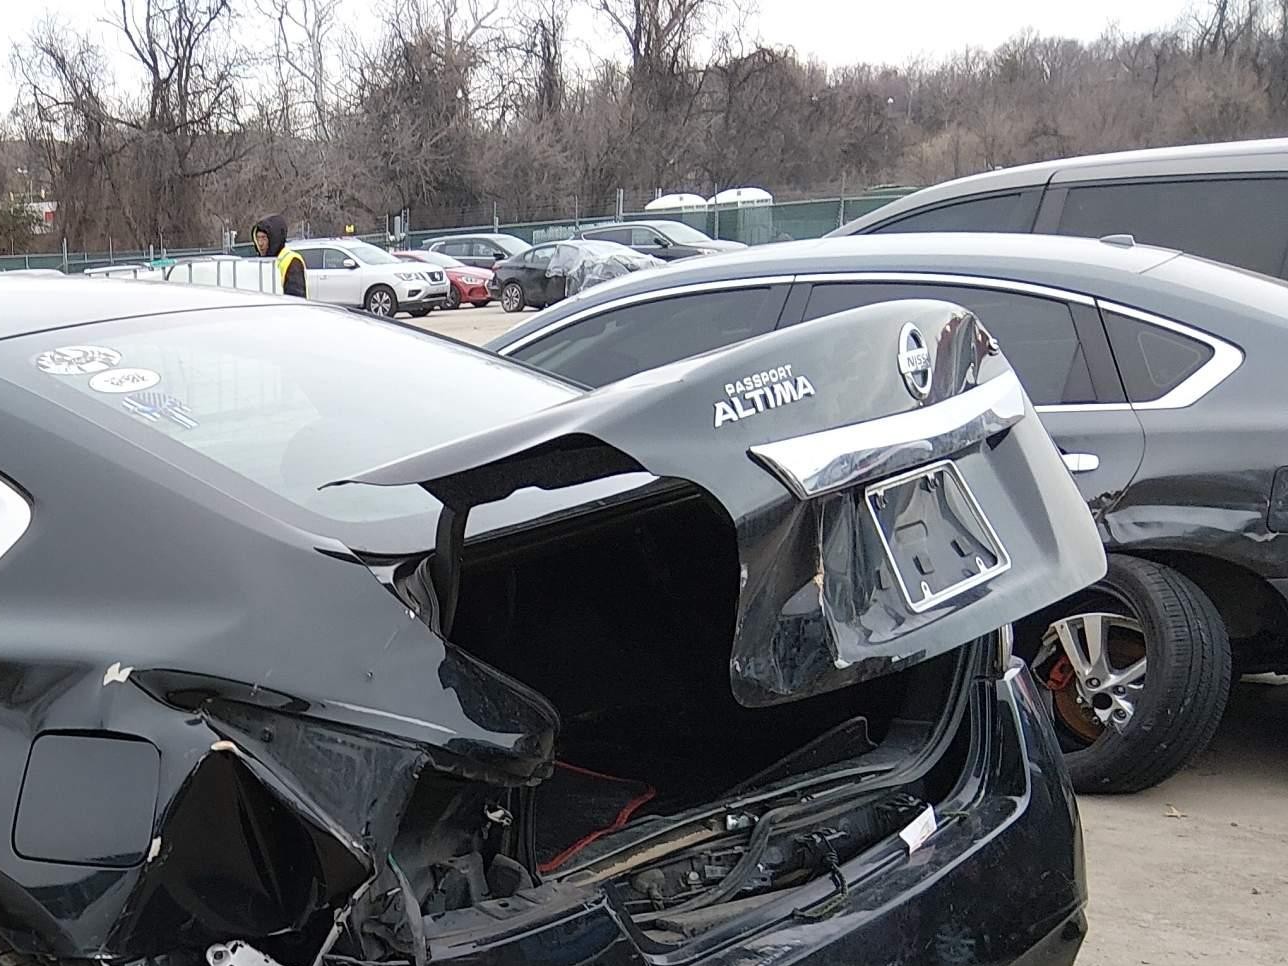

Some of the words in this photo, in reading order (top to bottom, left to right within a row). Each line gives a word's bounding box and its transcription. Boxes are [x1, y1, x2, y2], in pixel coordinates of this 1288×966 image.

[907, 352, 931, 368] NISS
[725, 364, 793, 397] PASSPORT
[714, 375, 816, 428] ALTIMA
